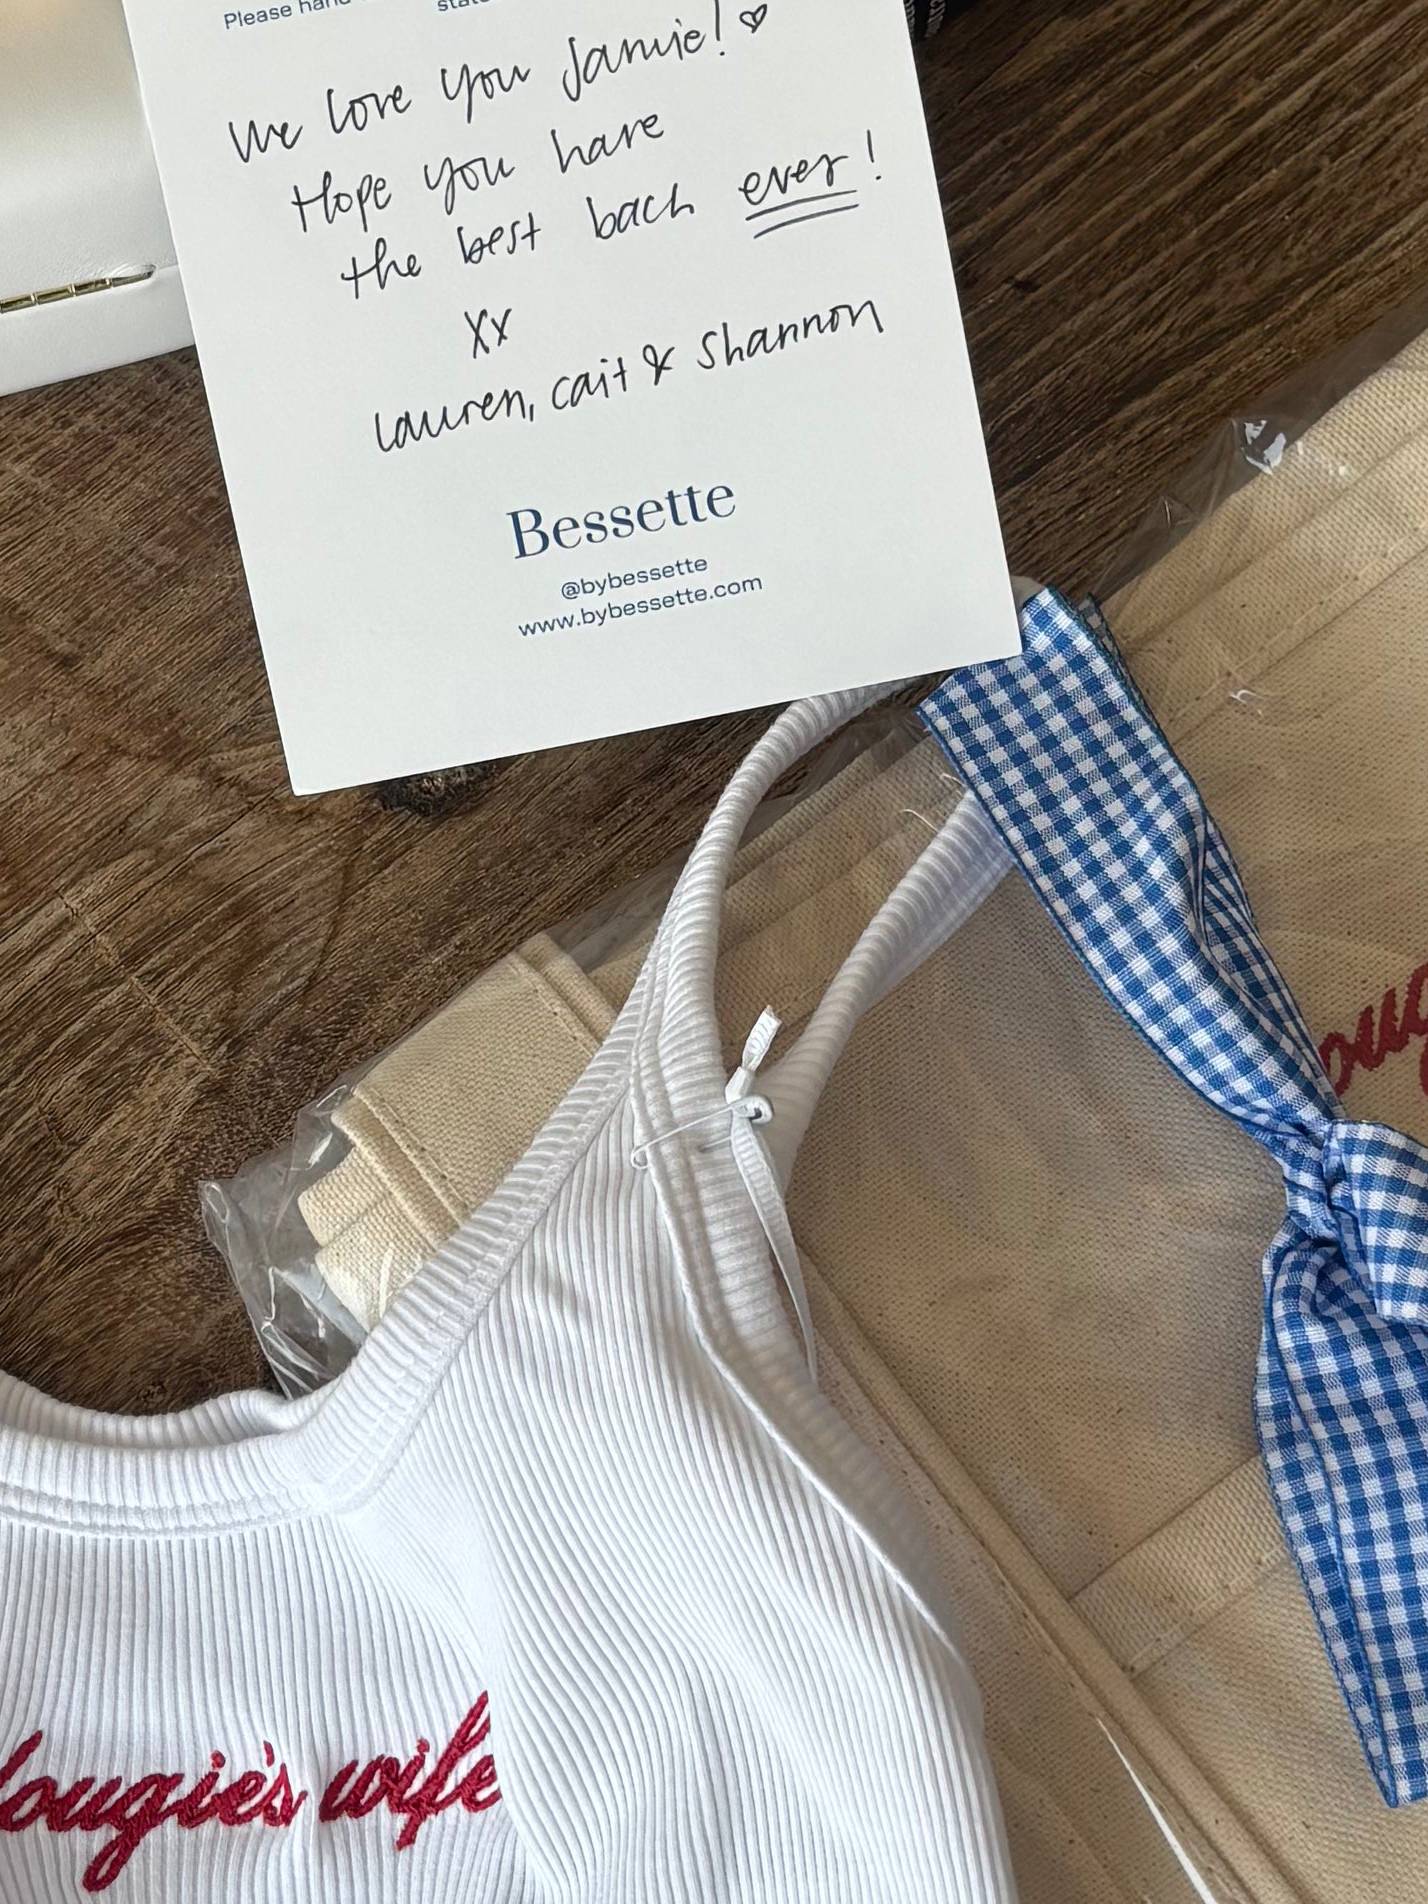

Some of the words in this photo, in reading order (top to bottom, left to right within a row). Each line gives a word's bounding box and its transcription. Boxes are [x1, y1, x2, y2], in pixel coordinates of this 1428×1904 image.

[222, 3, 294, 31] Please
[226, 118, 305, 165] We
[325, 83, 413, 136] love
[289, 172, 393, 235] Hope
[549, 112, 666, 168] have
[339, 236, 423, 301] the
[455, 210, 543, 266] best
[504, 484, 737, 561] Bessette
[517, 576, 764, 638] www.bybessette.com
[560, 557, 709, 602] @bybessette
[319, 1689, 503, 1852] wife
